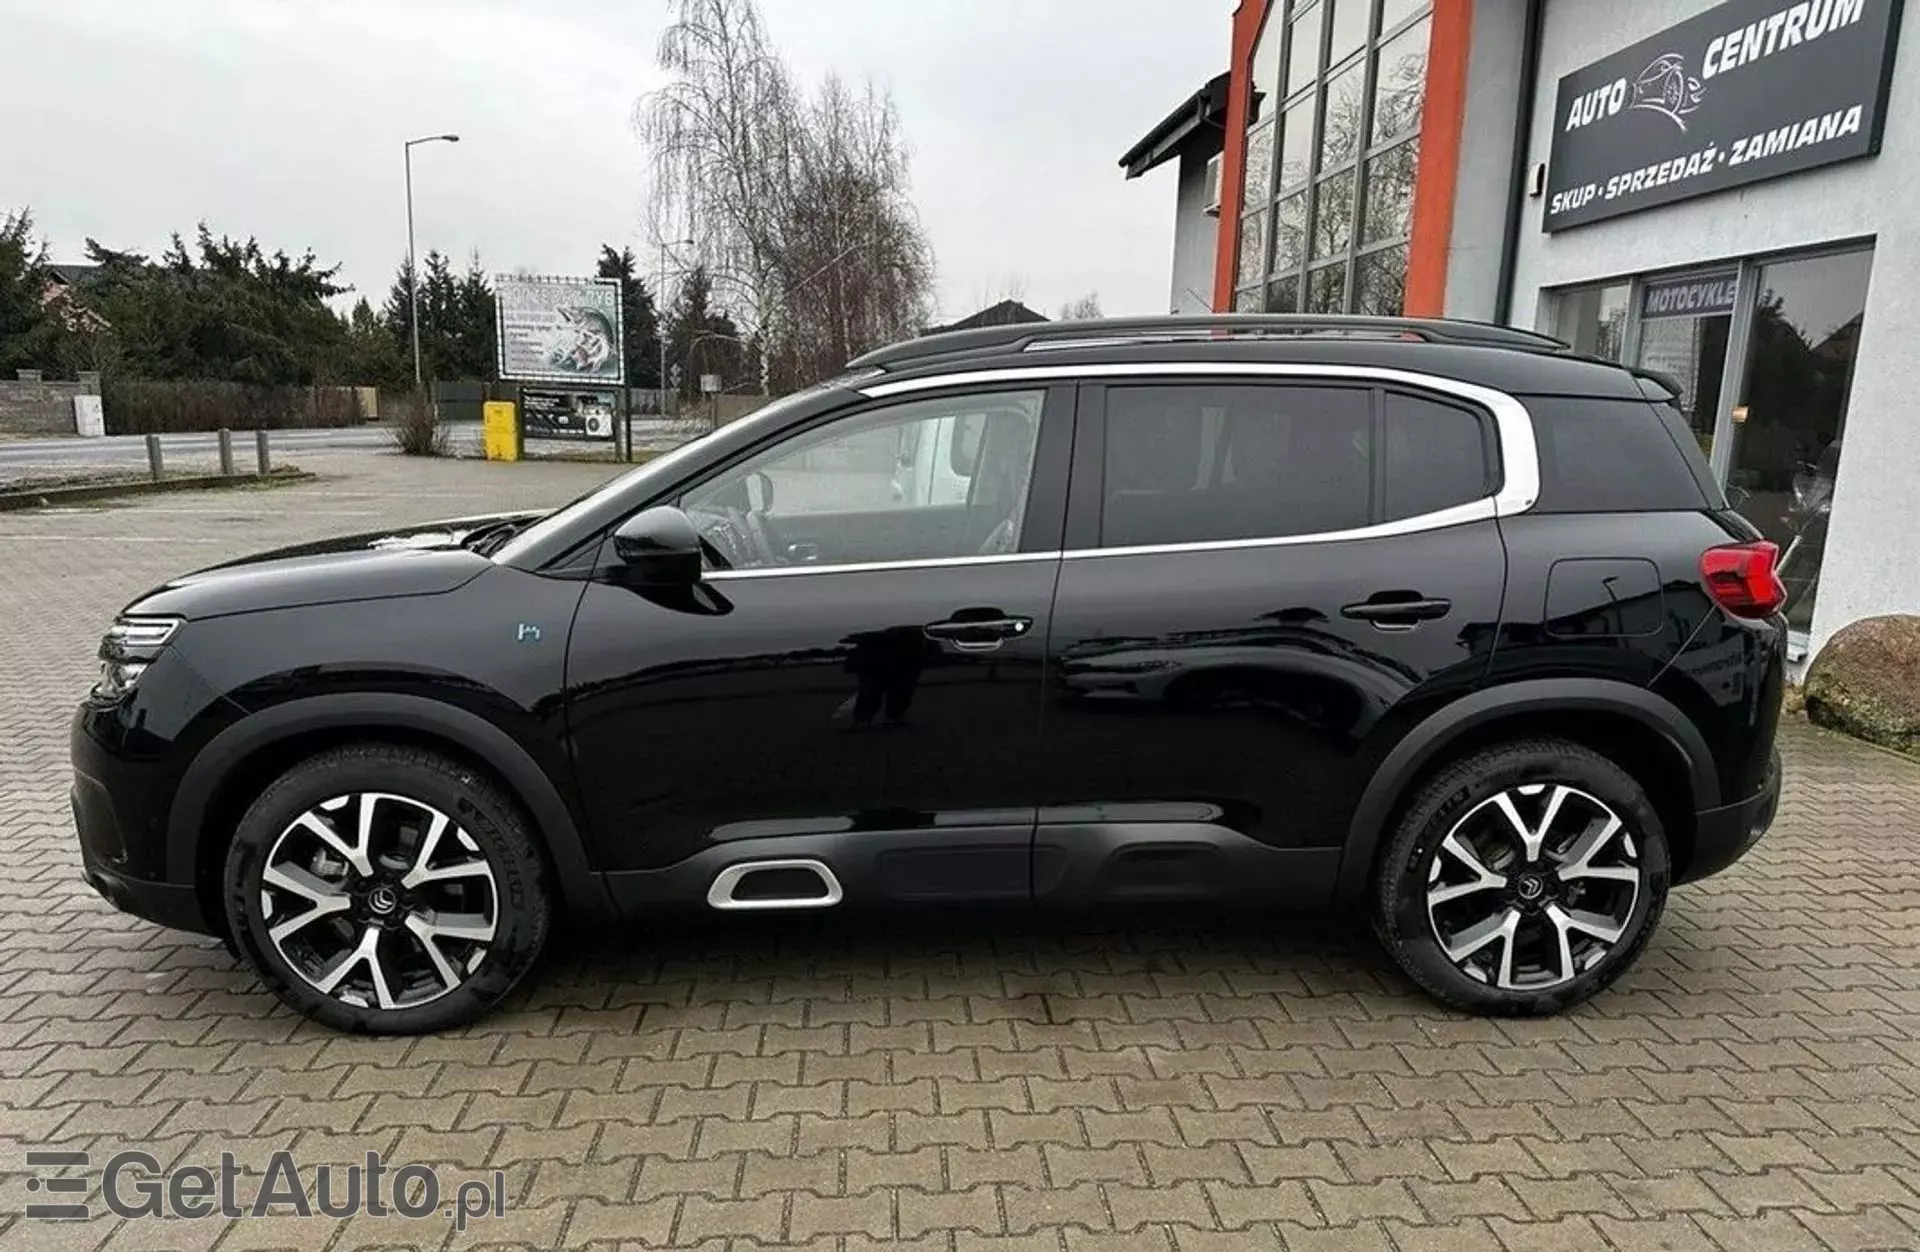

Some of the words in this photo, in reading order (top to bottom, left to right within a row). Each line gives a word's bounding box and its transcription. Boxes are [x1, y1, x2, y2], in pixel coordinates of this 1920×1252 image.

[1565, 76, 1627, 133] AUTO
[1701, 0, 1866, 80] CENTRUM
[1550, 184, 1595, 215] SKUP
[1604, 141, 1718, 201] SPRZEDAŻ
[1728, 104, 1863, 167] ZAMIANA
[1646, 279, 1737, 313] MOTOCYKLE
